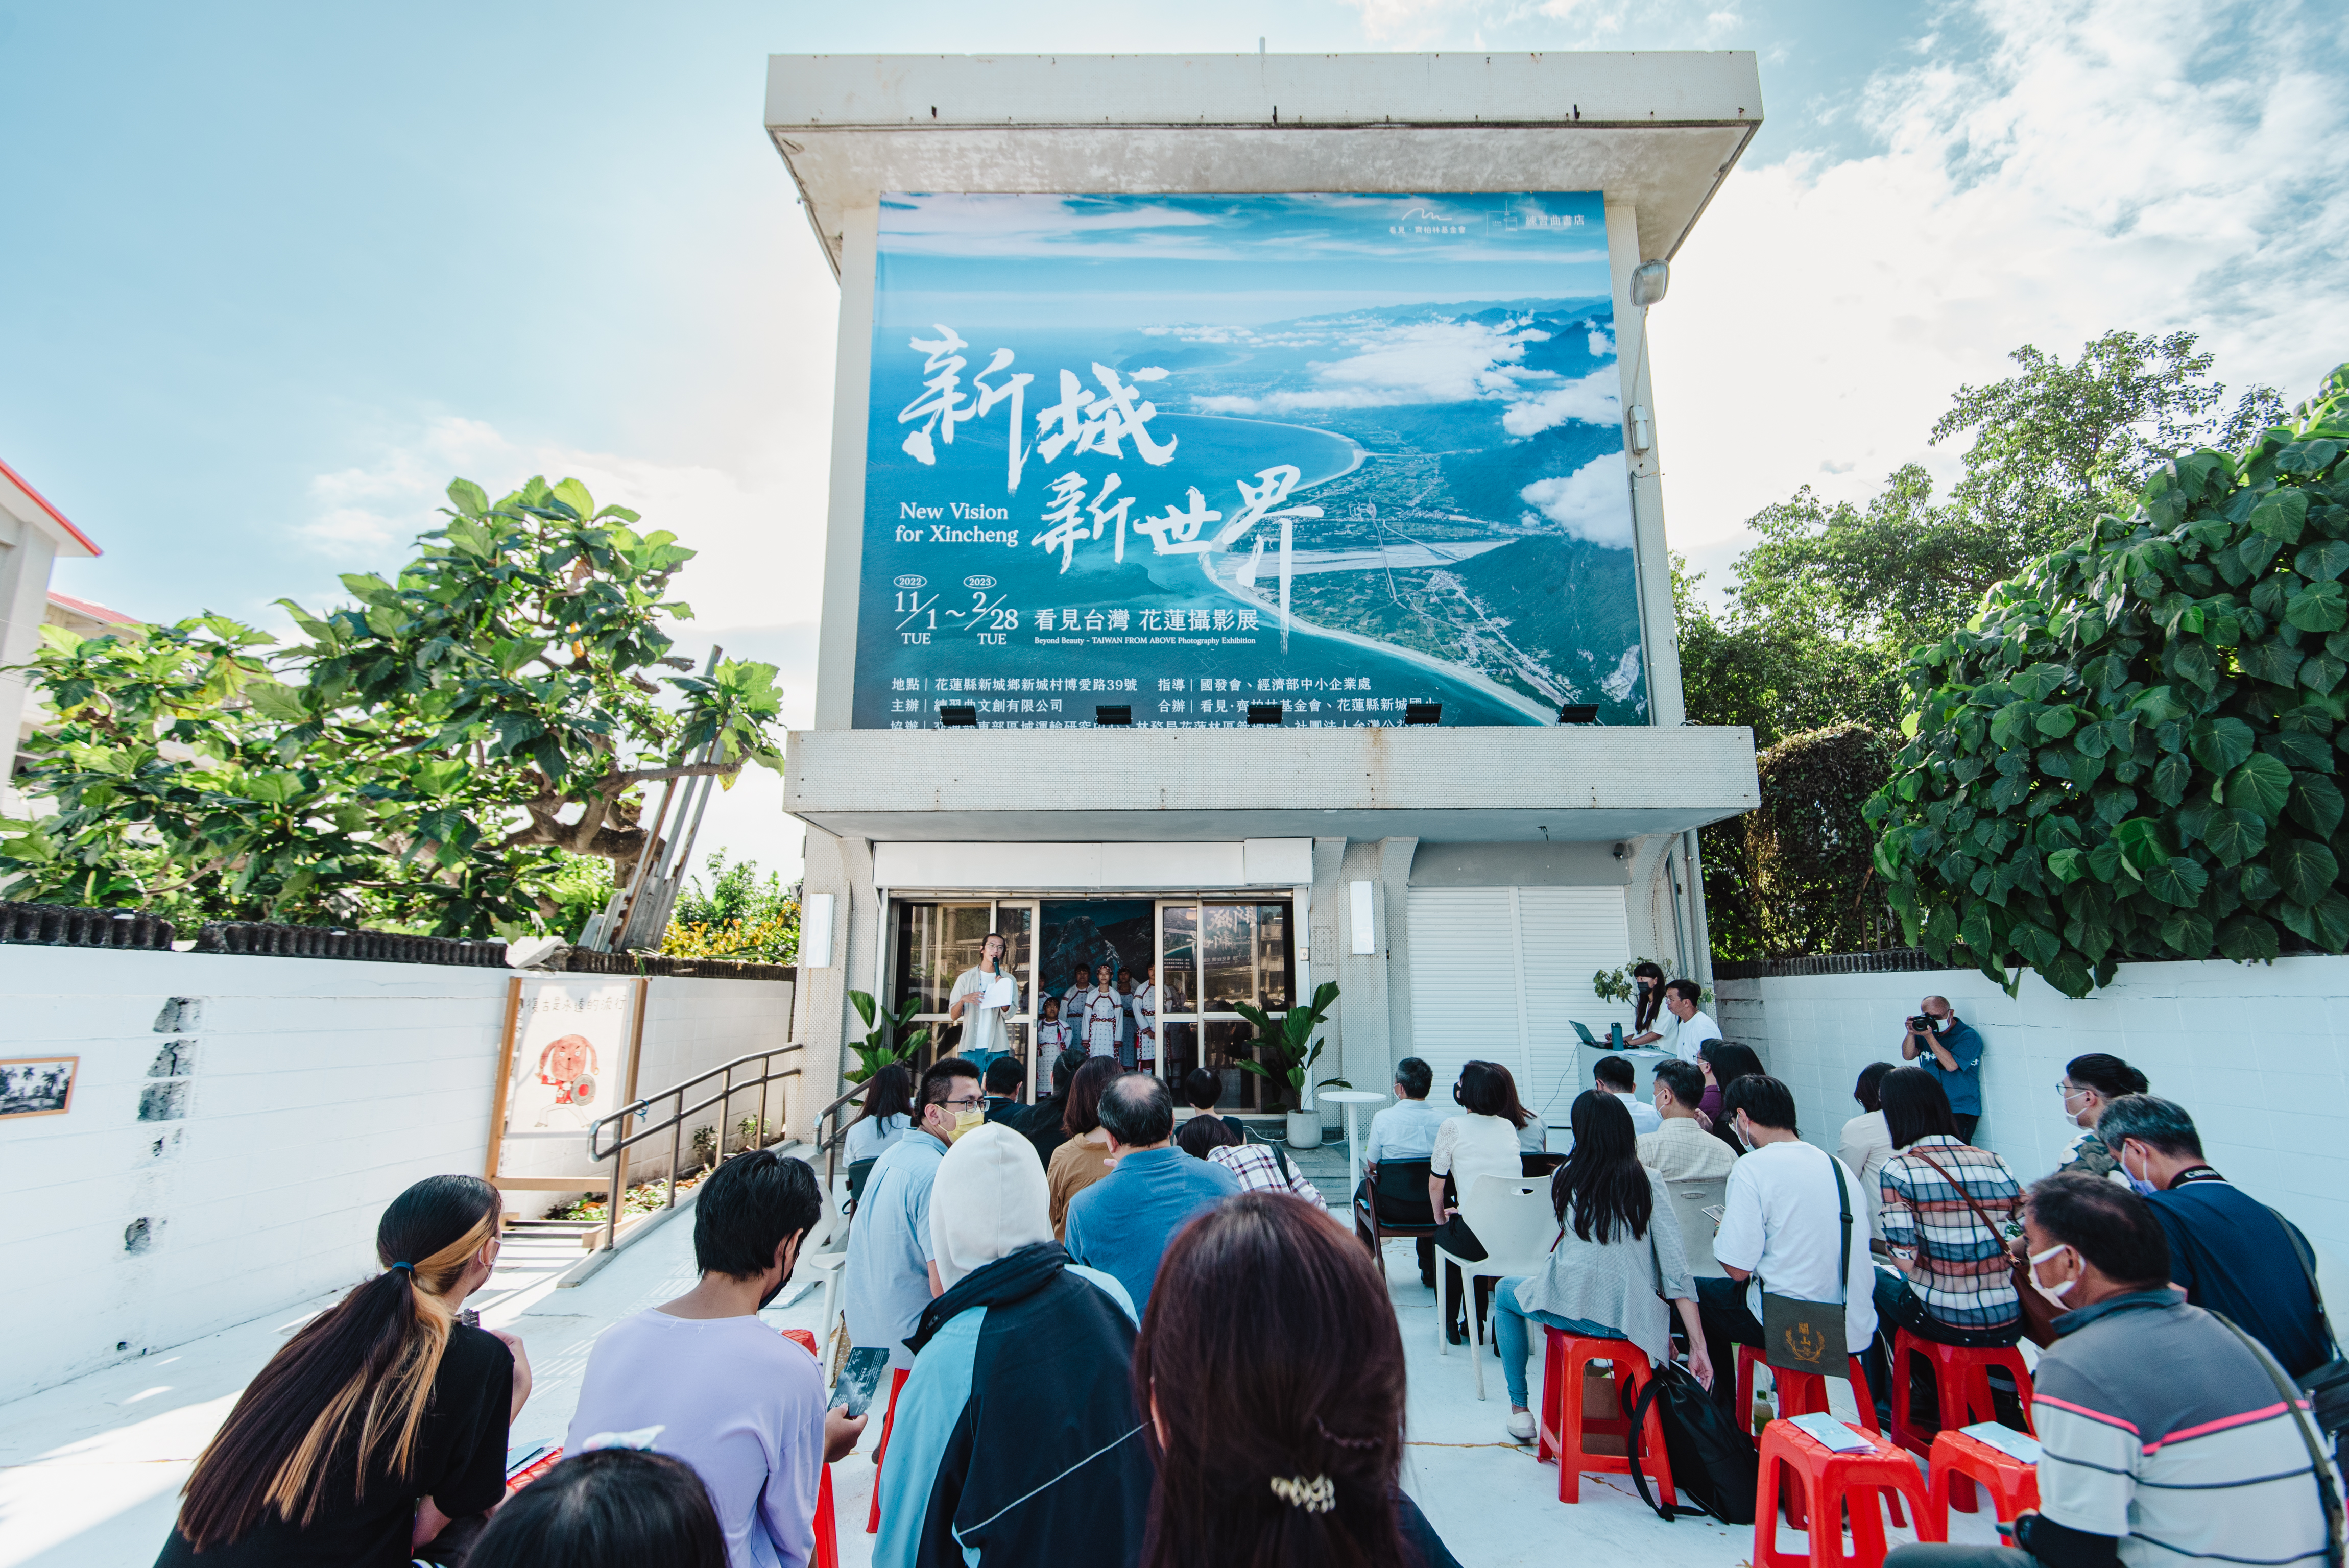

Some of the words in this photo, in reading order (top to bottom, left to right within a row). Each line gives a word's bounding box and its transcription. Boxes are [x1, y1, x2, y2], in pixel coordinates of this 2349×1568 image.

[1526, 214, 1585, 226] 練習曲書店
[898, 324, 1178, 495] 新城
[900, 502, 943, 519] New
[950, 502, 1009, 519] Vision
[895, 525, 924, 542] for
[929, 525, 1019, 547] Xincheng
[1032, 464, 1324, 655] 新世界
[899, 577, 921, 586] 2022
[1034, 608, 1130, 632] 看見台灣
[1139, 608, 1260, 632] 花蓮攝影展
[901, 633, 931, 645] TUE
[977, 633, 1006, 645] TUE
[1035, 637, 1059, 646] Beyond
[1062, 637, 1084, 646] Beauty
[1178, 637, 1220, 646] Photography
[526, 995, 627, 1014] 復古是永遠的流行
